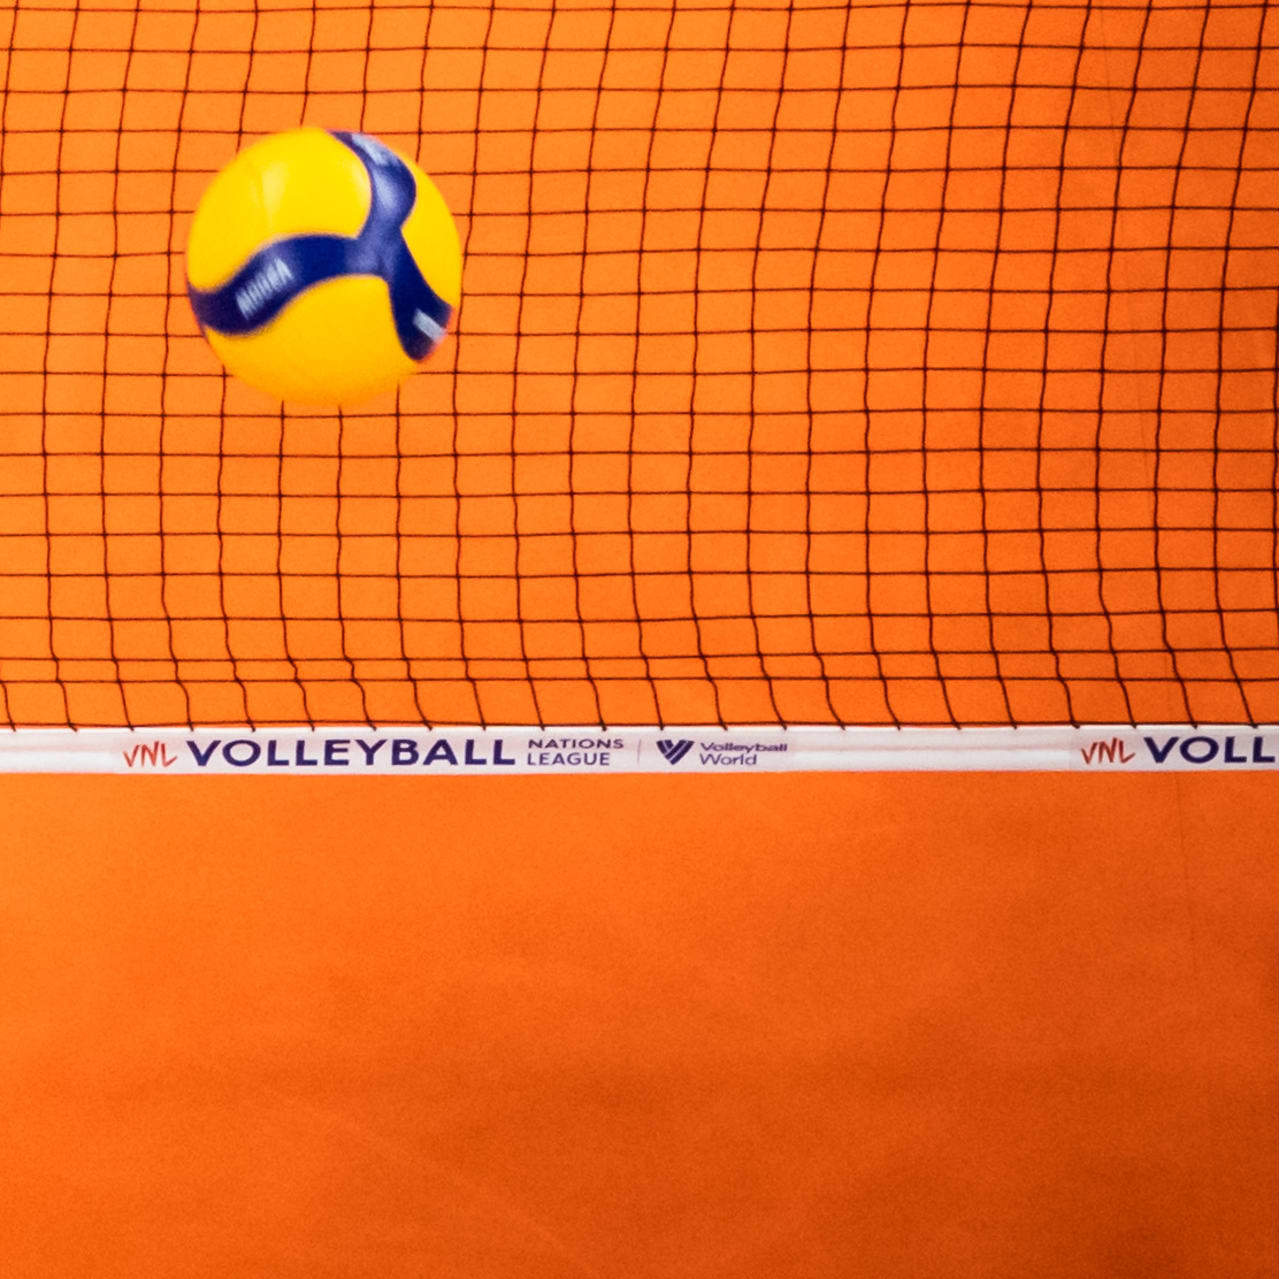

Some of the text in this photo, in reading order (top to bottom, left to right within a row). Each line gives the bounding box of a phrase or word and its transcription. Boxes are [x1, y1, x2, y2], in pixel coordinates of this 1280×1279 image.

[528, 738, 624, 750] NATIONS
[700, 741, 788, 753] Volleyball
[1081, 736, 1276, 765] VNL VOLL
[122, 738, 516, 768] VNL VOLLEYBALL
[527, 752, 610, 766] LEAGUE
[699, 752, 758, 766] World
